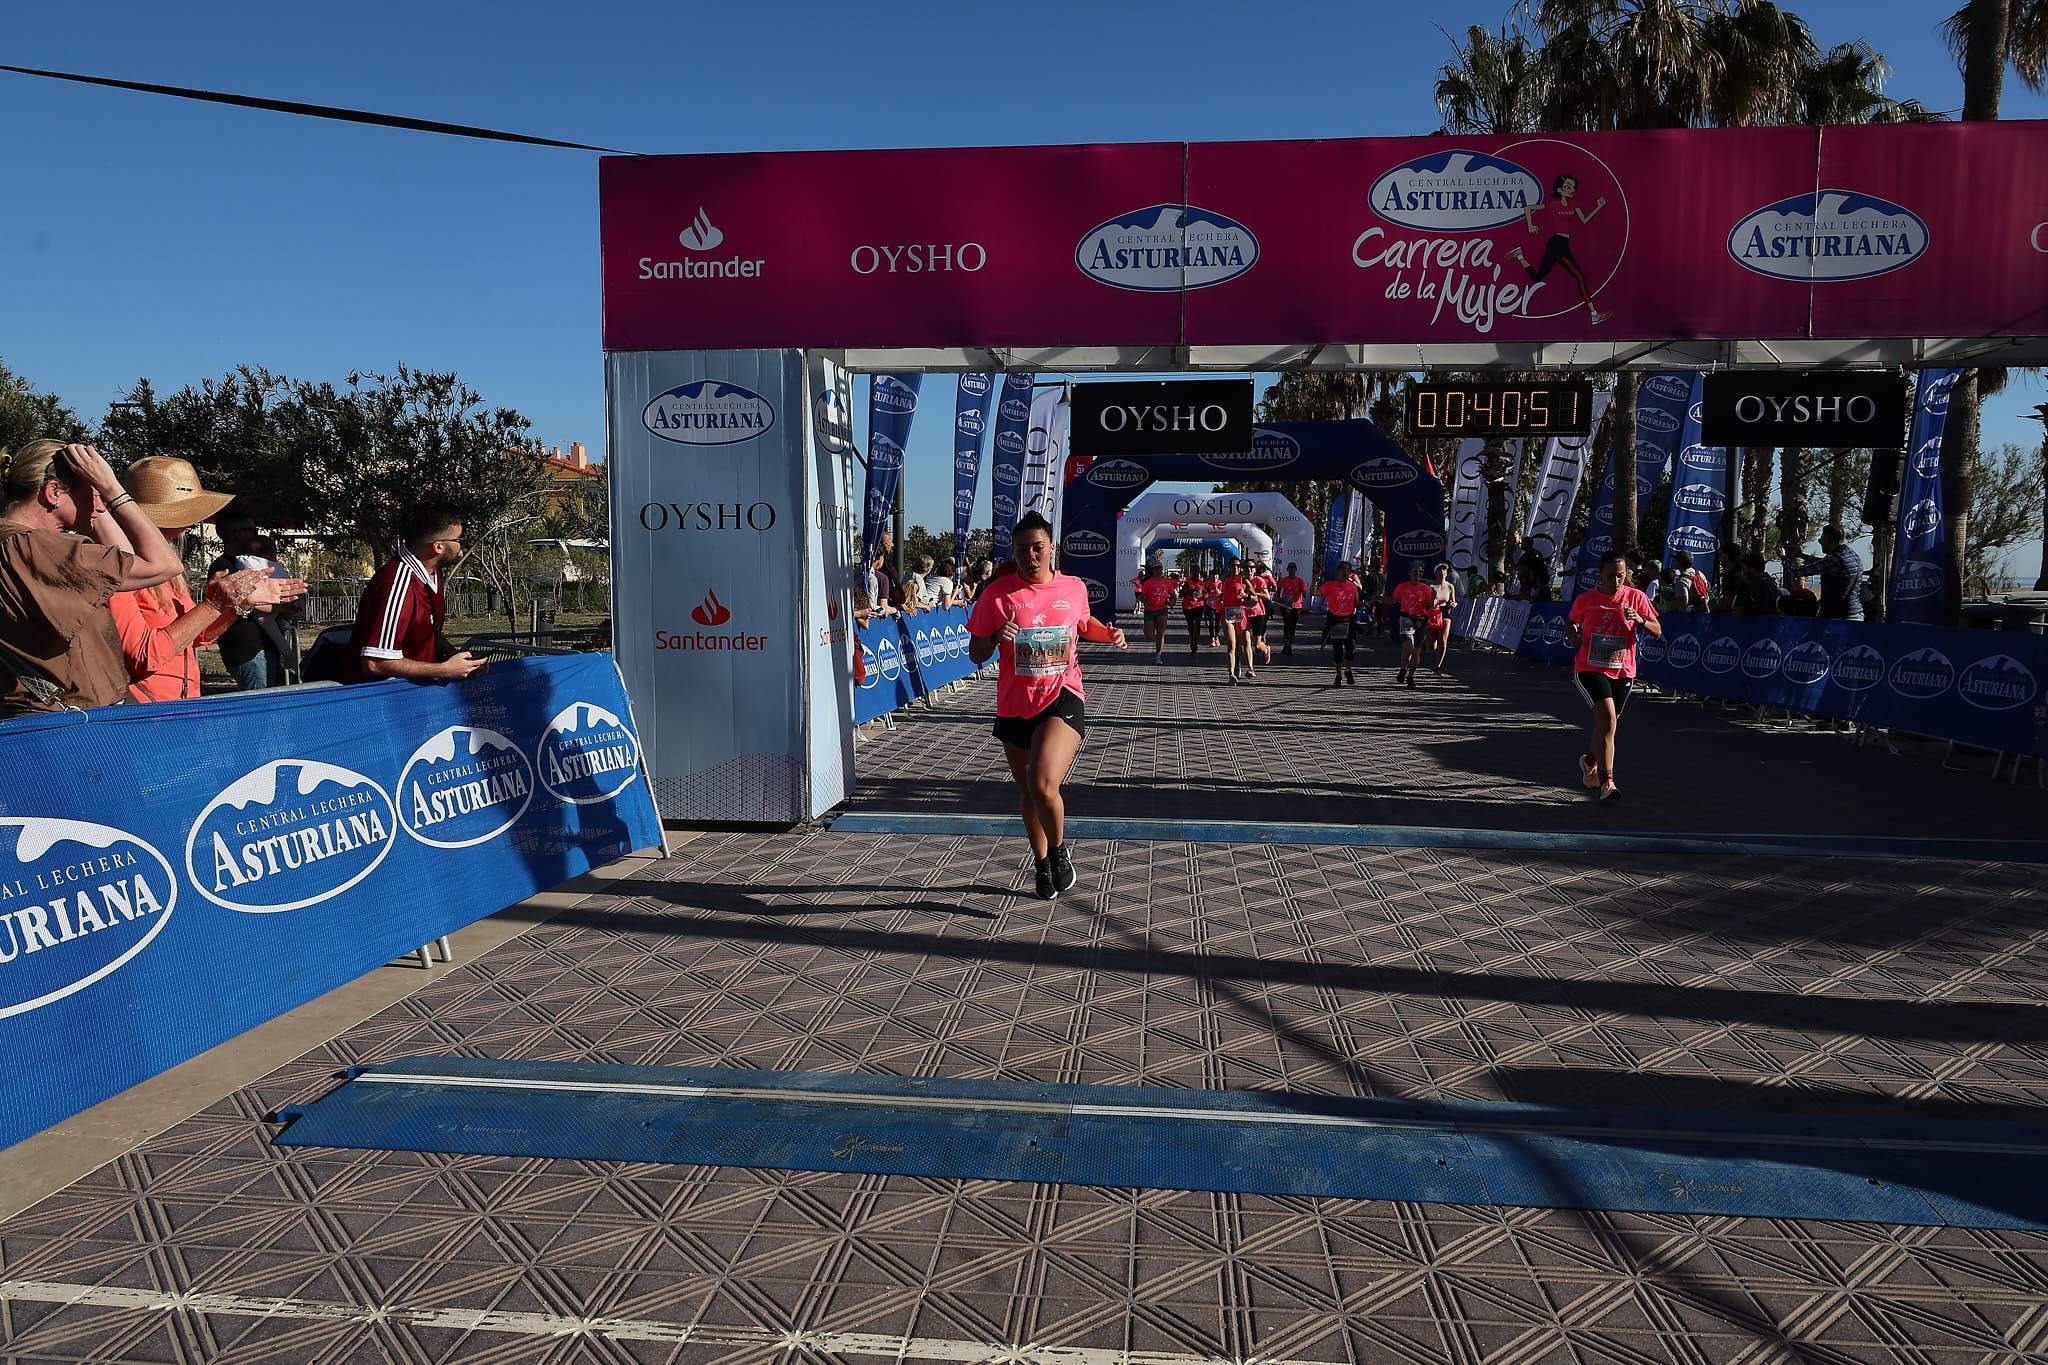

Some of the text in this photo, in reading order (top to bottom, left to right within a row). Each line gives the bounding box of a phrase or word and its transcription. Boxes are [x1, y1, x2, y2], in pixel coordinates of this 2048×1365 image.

[1382, 181, 1530, 211] ASTURIANA
[1409, 176, 1525, 187] CENTRAL LECHERA
[1117, 234, 1176, 245] CENTRAL
[1842, 220, 1907, 231] LECHERA
[1090, 238, 1246, 270] ASTURIANA
[1352, 226, 1494, 269] Carrera
[1743, 225, 1913, 258] ASTURIANA
[638, 255, 766, 280] Santander
[850, 242, 987, 274] OYSHO
[1385, 264, 1547, 333] de la Mujer
[652, 404, 765, 430] ASTURIANA
[672, 402, 761, 411] CENTRAL LECHERA
[1100, 404, 1228, 432] OYSHO
[1735, 395, 1876, 423] OYSHO
[1090, 469, 1144, 482] ASTURIANA
[640, 502, 776, 531] OYSHO
[816, 501, 850, 532] OYSHO
[1173, 499, 1253, 516] OYSHO
[655, 631, 768, 651] Santander
[1961, 671, 2027, 701] ASTURIANA
[559, 736, 593, 751] CENTRAL
[428, 765, 473, 785] CENTRAL
[549, 744, 635, 787] ASTURIANA
[236, 790, 373, 836] CENTRAL LECHERA
[413, 769, 528, 830] ASTURIANA
[212, 808, 389, 894] ASTURIANA
[37, 851, 138, 889] LECHERA
[0, 873, 162, 964] URIANA
